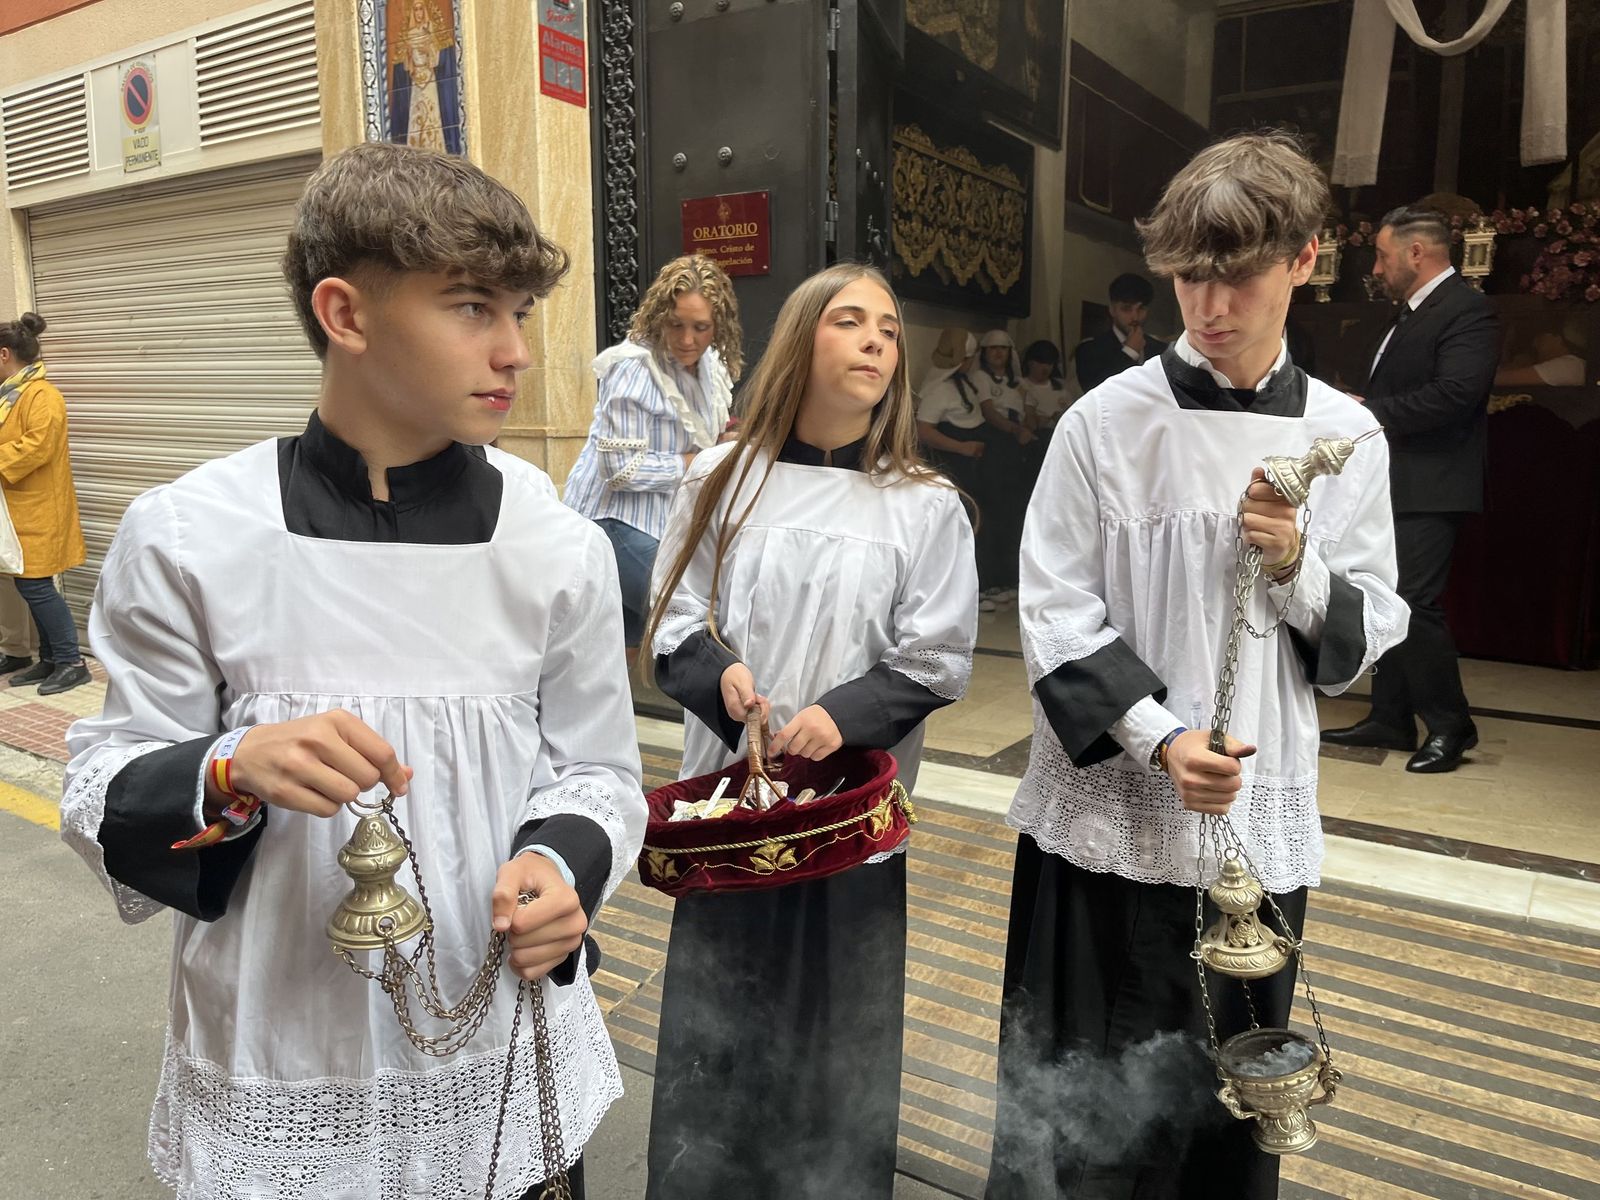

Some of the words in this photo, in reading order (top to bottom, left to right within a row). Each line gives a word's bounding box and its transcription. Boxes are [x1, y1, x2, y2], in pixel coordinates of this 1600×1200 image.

[543, 30, 582, 57] Alarma
[132, 136, 149, 149] VADO
[125, 149, 159, 167] PERMANENTE
[693, 222, 758, 239] ORATORIO
[720, 245, 743, 254] Cristo
[745, 243, 755, 252] de
[714, 257, 753, 267] lagelación
